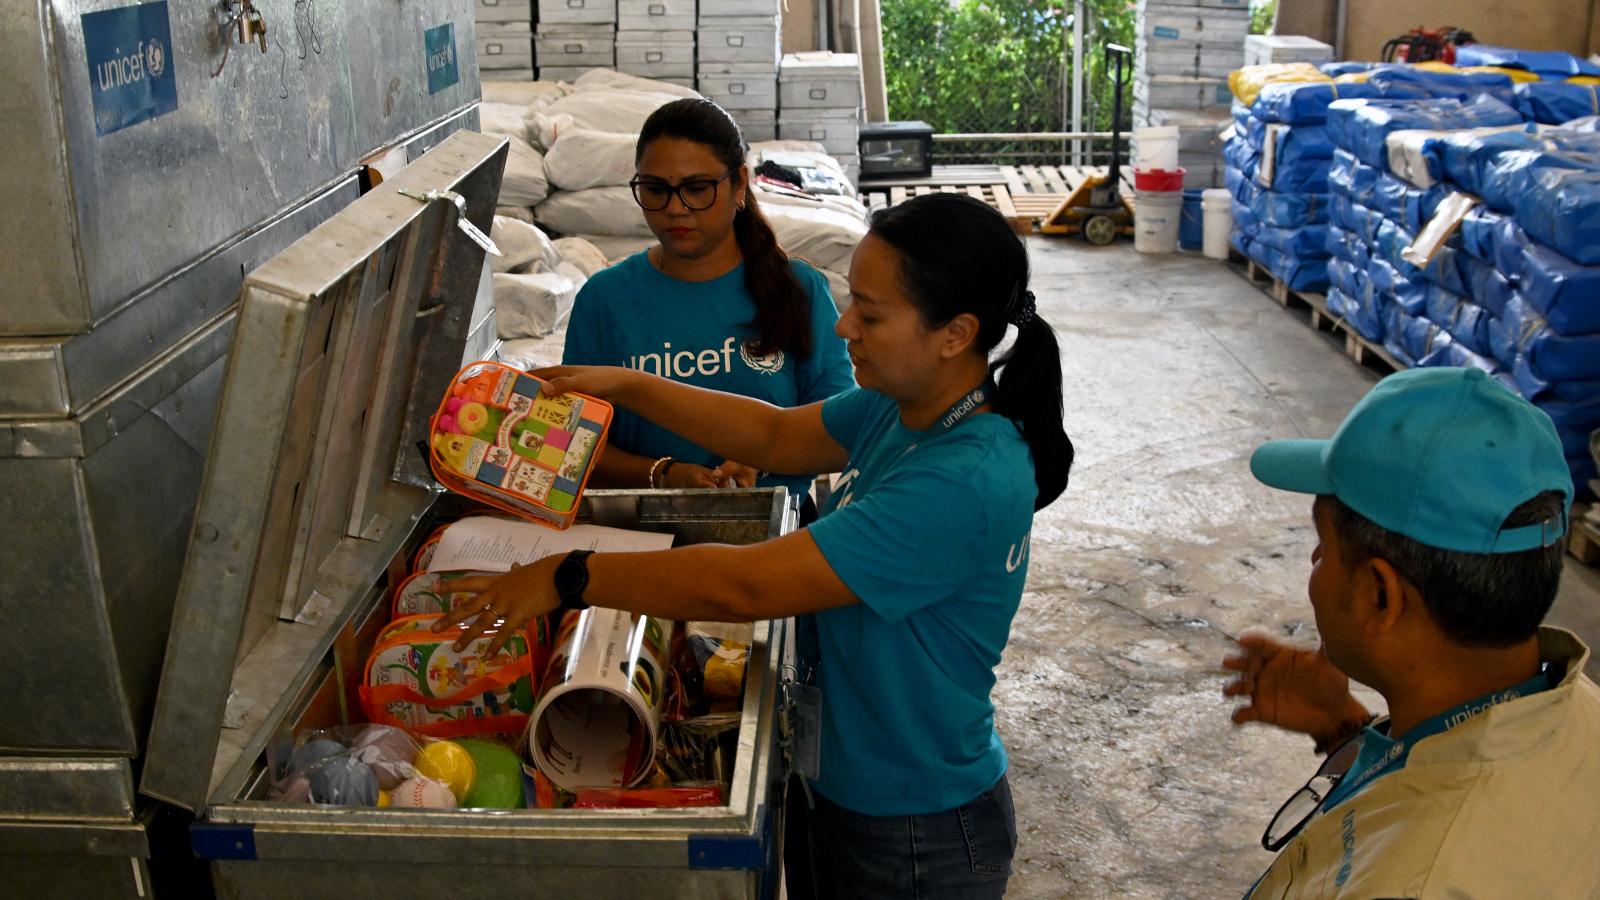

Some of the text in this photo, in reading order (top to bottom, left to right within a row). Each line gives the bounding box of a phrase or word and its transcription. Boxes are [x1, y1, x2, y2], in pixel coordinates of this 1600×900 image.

[97, 41, 145, 92] unicef
[429, 44, 447, 72] unicef
[942, 395, 976, 428] unicef
[1342, 808, 1357, 863] unice
